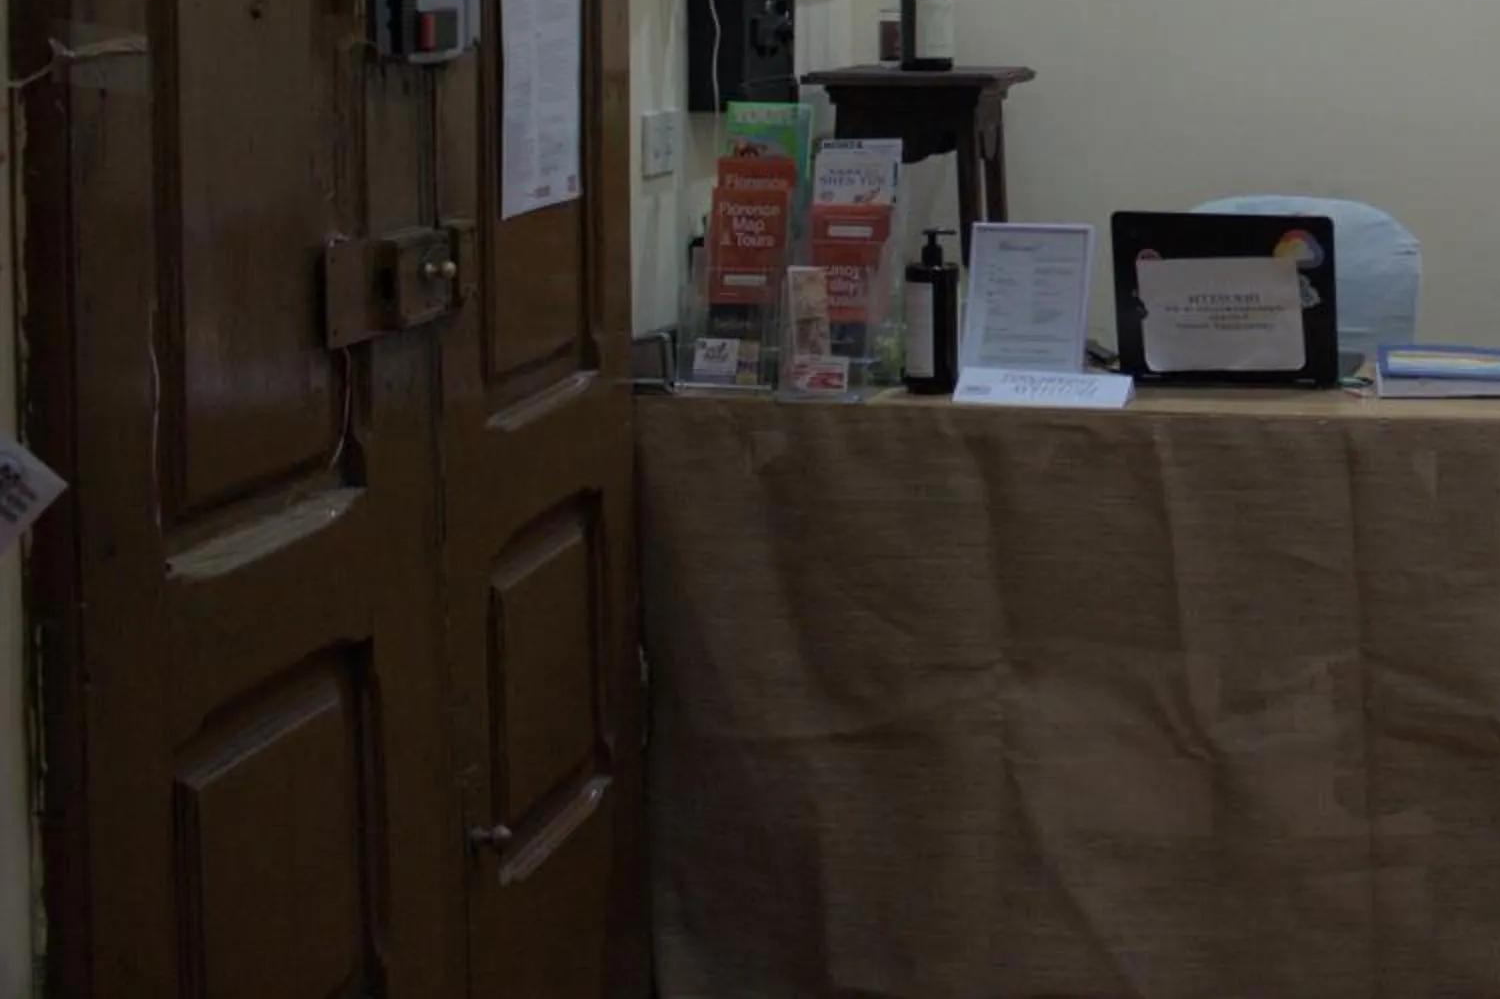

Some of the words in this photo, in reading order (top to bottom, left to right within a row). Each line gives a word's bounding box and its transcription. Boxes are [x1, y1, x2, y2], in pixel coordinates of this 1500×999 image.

[719, 202, 781, 216] Florence
[733, 216, 765, 233] Map
[736, 232, 776, 247] Tours
